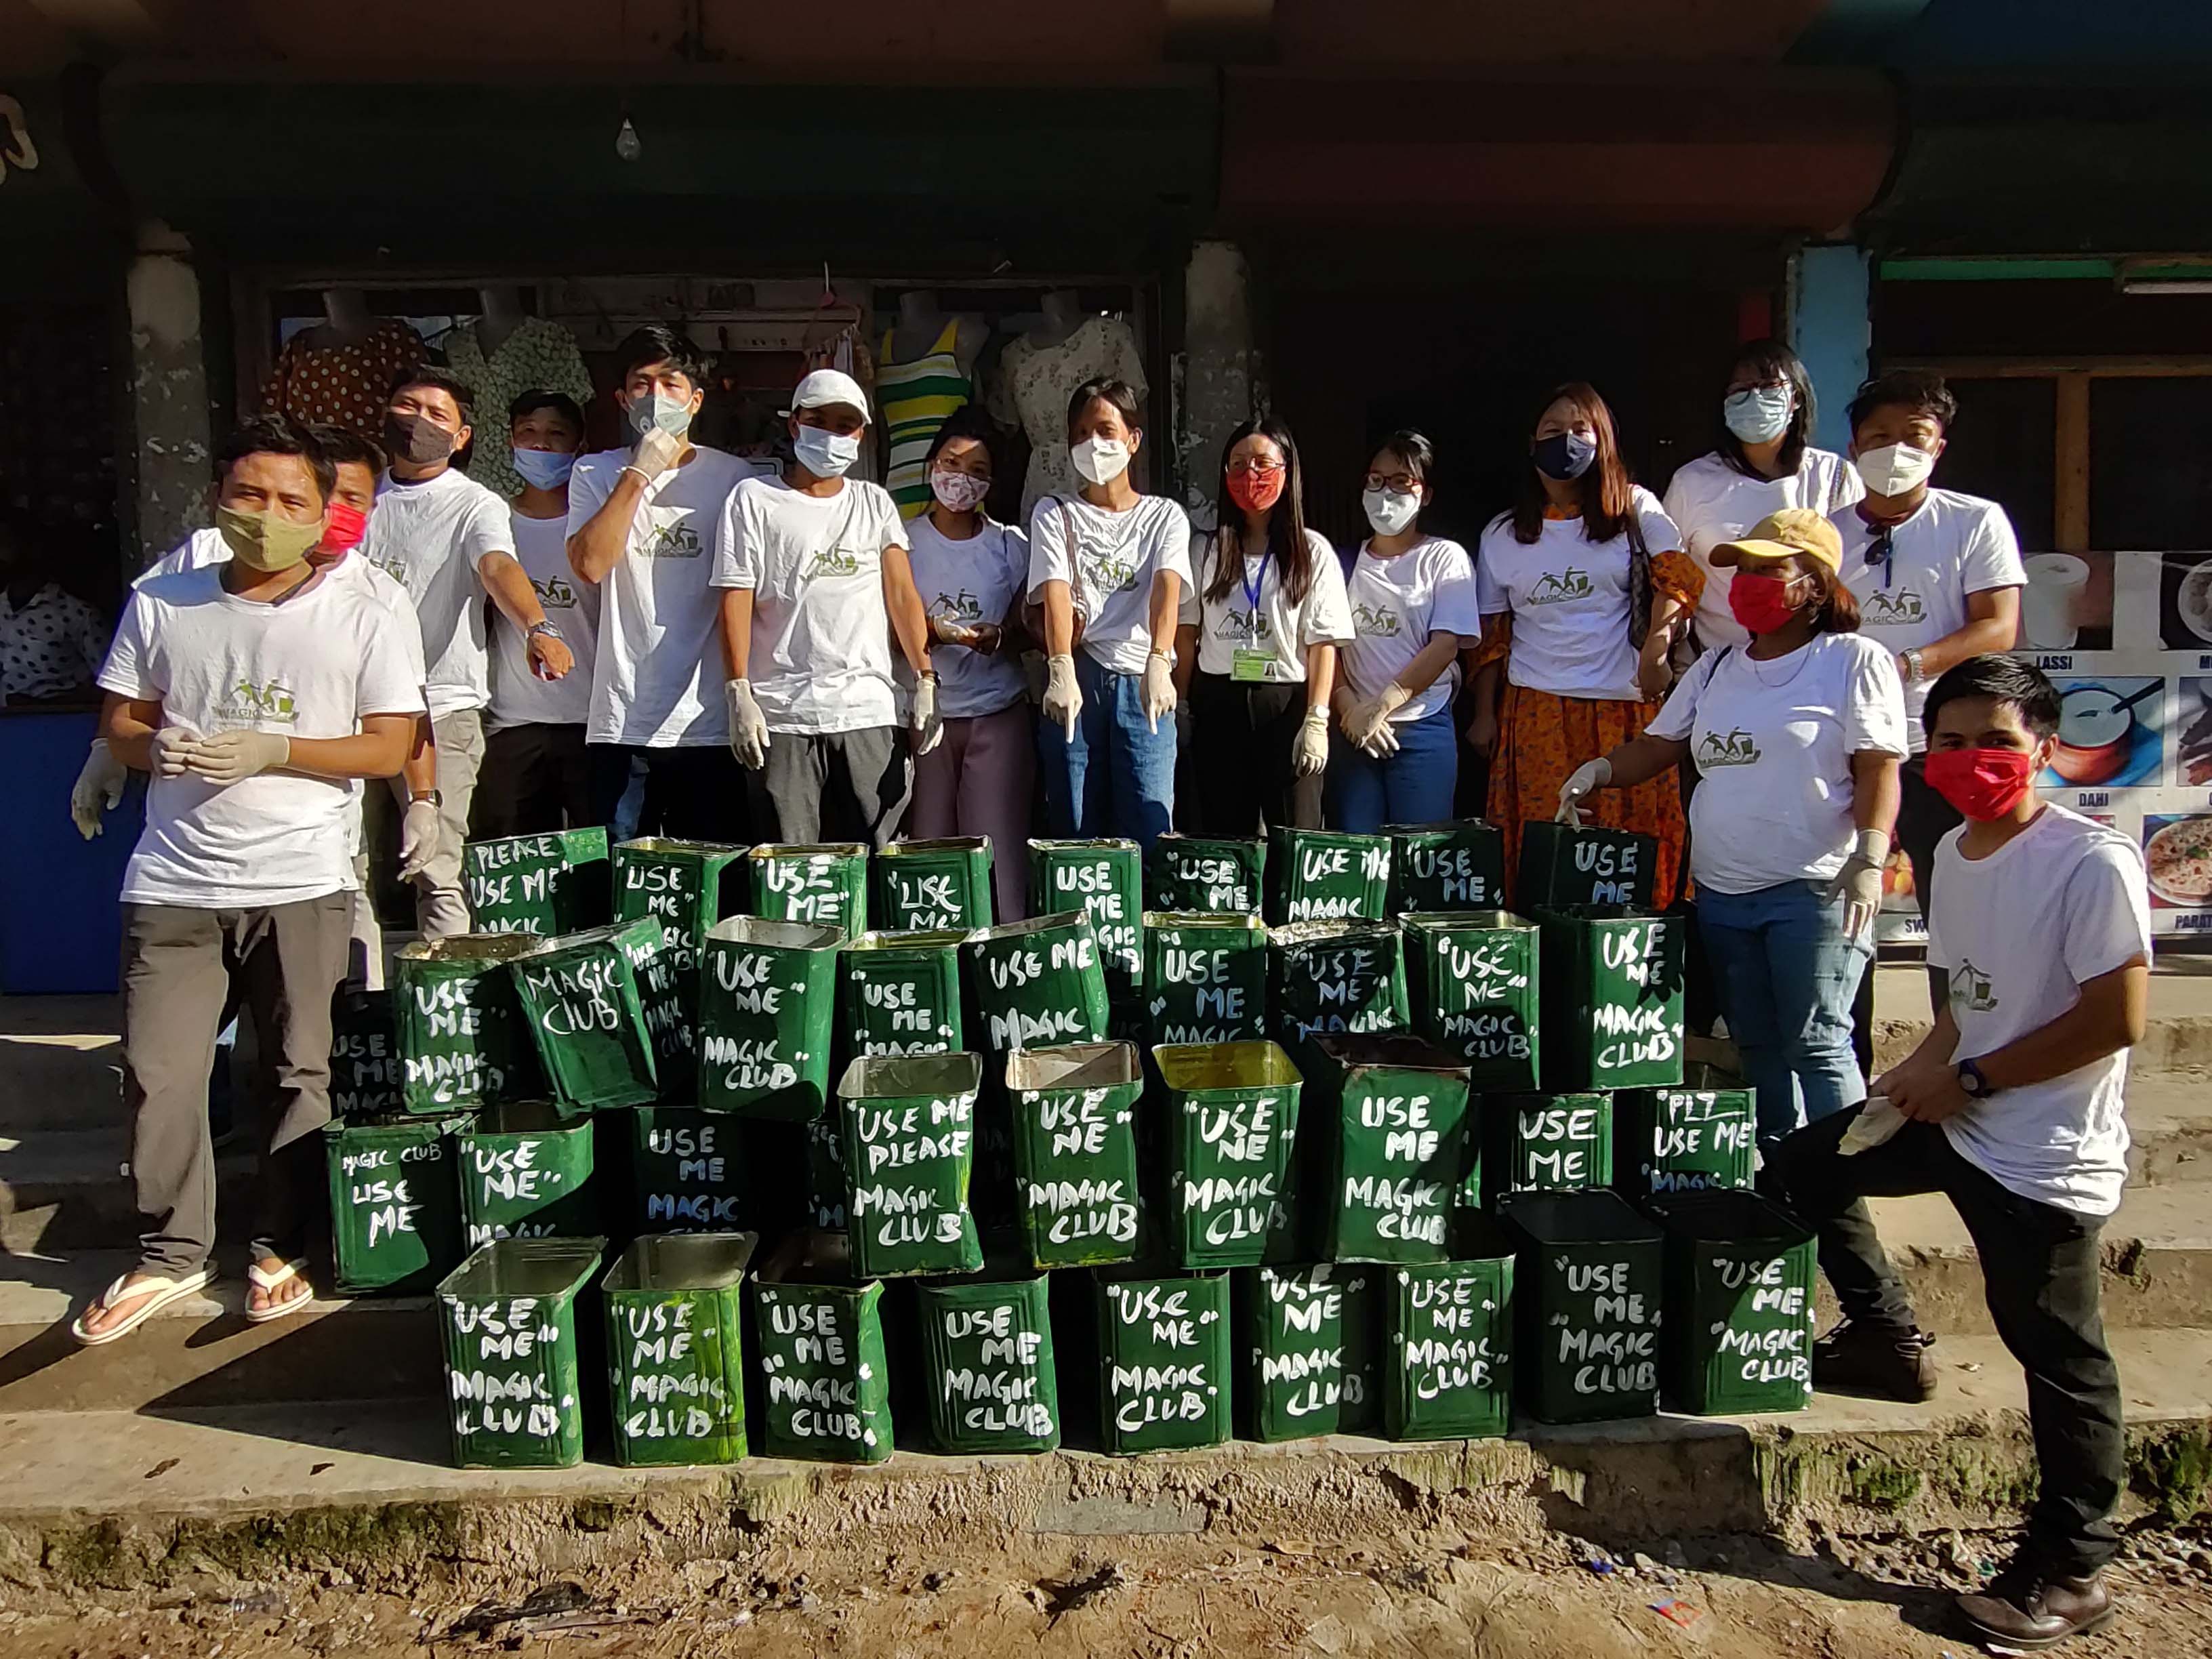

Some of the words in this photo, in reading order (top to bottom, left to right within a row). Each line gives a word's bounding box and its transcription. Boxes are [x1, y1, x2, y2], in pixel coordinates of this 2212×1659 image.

[2078, 792, 2109, 807] DAHI
[476, 837, 558, 874] PLEASE
[1574, 841, 1638, 876] USE
[470, 874, 514, 909] USE
[1057, 861, 1112, 893] USE
[1085, 893, 1124, 922] ME
[1210, 885, 1251, 910] ME
[1051, 937, 1095, 970] ME
[1602, 924, 1666, 970] USE
[1195, 987, 1246, 1019] ME
[893, 1009, 933, 1031] ME
[1465, 1034, 1530, 1059] CLUB
[1597, 1031, 1675, 1069] CLUB
[725, 1063, 797, 1090] CLUB
[930, 1094, 975, 1126] ME
[1361, 1095, 1431, 1130] USE
[1518, 1109, 1599, 1141] USE
[649, 1126, 716, 1157] USE
[869, 1130, 972, 1176] PLEASE
[1384, 1130, 1439, 1162] ME
[1654, 1126, 1702, 1158] USE
[1714, 1120, 1753, 1156] ME
[342, 1149, 394, 1176] MAGIC
[401, 1143, 443, 1163] CLUB
[679, 1157, 726, 1182] ME
[1528, 1149, 1587, 1183] ME
[352, 1179, 414, 1205] USE
[648, 1193, 740, 1223] MAGIC
[1345, 1176, 1443, 1217] MAGIC
[369, 1204, 426, 1248] ME
[878, 1212, 964, 1248] CLUB
[1048, 1204, 1138, 1245] CLUB
[1376, 1212, 1448, 1246] CLUB
[1282, 1292, 1343, 1338] ME
[1594, 1293, 1645, 1324] ME
[1752, 1286, 1805, 1315] ME
[946, 1305, 1013, 1339] USE
[1433, 1307, 1474, 1335] ME
[795, 1336, 846, 1366] ME
[981, 1331, 1042, 1366] ME
[1559, 1328, 1655, 1366] MAGIC
[1717, 1328, 1805, 1357] MAGIC
[1417, 1359, 1494, 1399] CLUB
[1574, 1361, 1657, 1394] CLUB
[1741, 1354, 1809, 1382] CLUB
[945, 1368, 1038, 1405] MAGIC
[964, 1403, 1054, 1437] CLUB
[1116, 1390, 1207, 1433] CLUB
